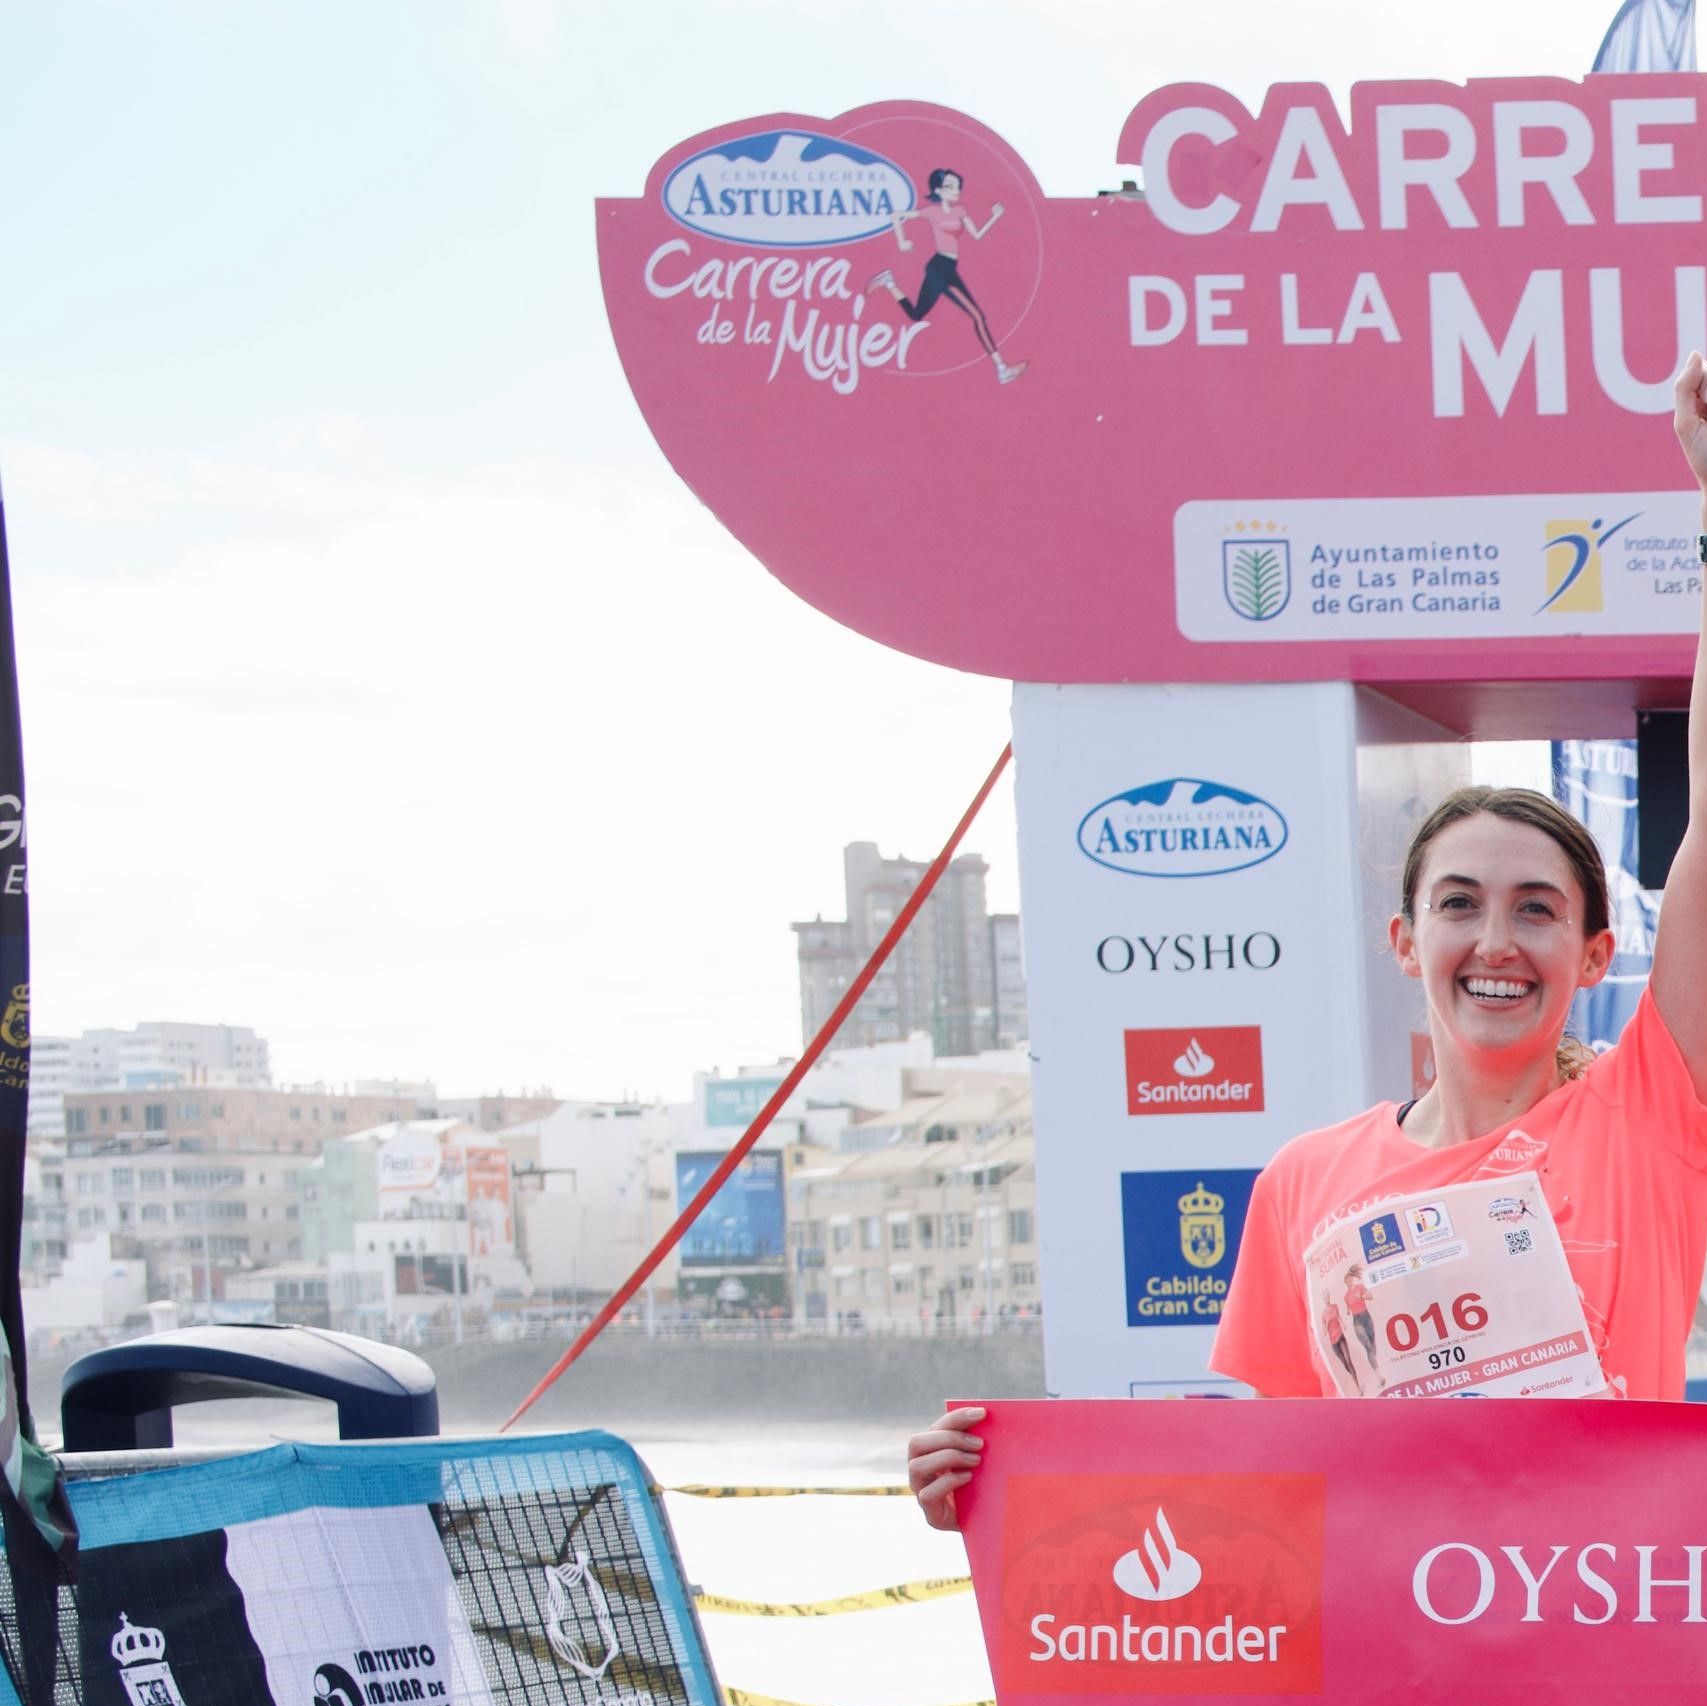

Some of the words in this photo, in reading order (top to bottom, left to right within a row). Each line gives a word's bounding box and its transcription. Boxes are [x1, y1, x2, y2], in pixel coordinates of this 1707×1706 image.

[684, 172, 894, 217] ASTURIANA
[643, 238, 852, 299] Carrera
[1129, 274, 1249, 346] DE
[1281, 272, 1402, 345] LA
[697, 302, 736, 344] de
[743, 302, 773, 344] la
[767, 296, 930, 395] Mujer
[1311, 541, 1499, 568] Ayuntamiento
[1624, 536, 1689, 551] Instituto
[1311, 569, 1341, 589] de
[1358, 568, 1396, 588] Las
[1412, 565, 1500, 588] Palmas
[1654, 580, 1682, 594] Las
[1312, 595, 1341, 614] de
[1348, 595, 1403, 613] Gran
[1412, 591, 1501, 612] Canaria
[1095, 816, 1273, 855] ASTURIANA
[1096, 931, 1281, 974] OYSHO
[1136, 1080, 1254, 1104] Santander
[1146, 1276, 1226, 1297] Cabildo
[1138, 1296, 1204, 1319] Gran
[1385, 1291, 1489, 1352] 016
[1425, 1372, 1472, 1393] MUJER
[1482, 1359, 1519, 1377] GRAN
[1520, 1338, 1579, 1366] CANARIA
[1428, 1346, 1467, 1370] 970
[1530, 1375, 1575, 1394] Santander
[1030, 1613, 1287, 1663] Santander
